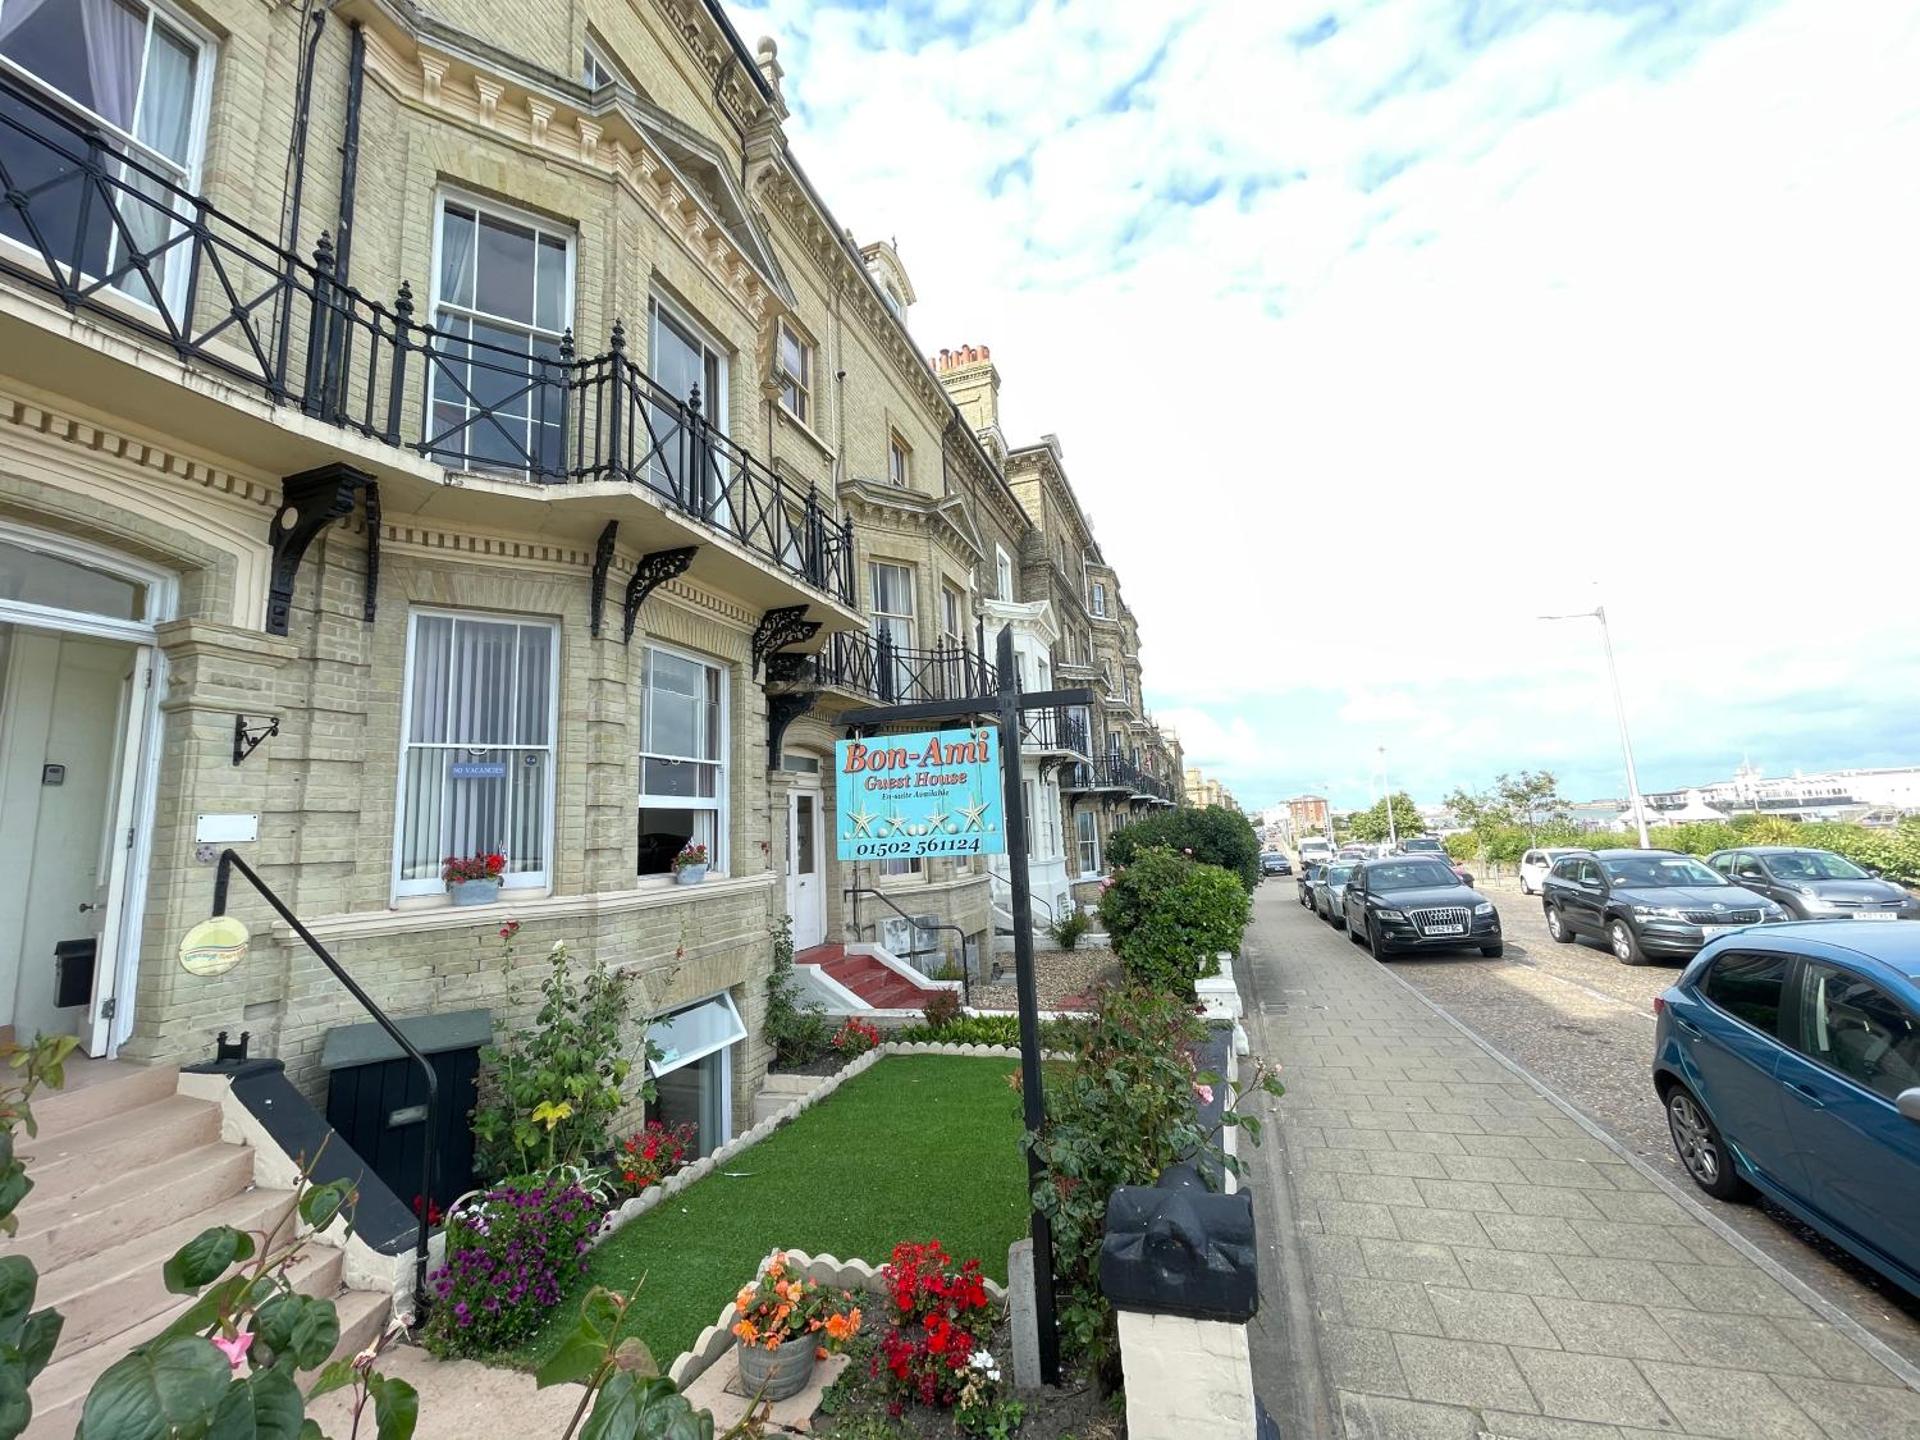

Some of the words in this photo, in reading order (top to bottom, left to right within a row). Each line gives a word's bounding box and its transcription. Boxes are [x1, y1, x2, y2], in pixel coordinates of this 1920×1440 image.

[842, 730, 991, 775] Bon-Ami
[864, 775, 912, 791] Guest
[914, 771, 968, 787] House
[856, 841, 911, 857] 01502
[915, 838, 980, 856] 561124
